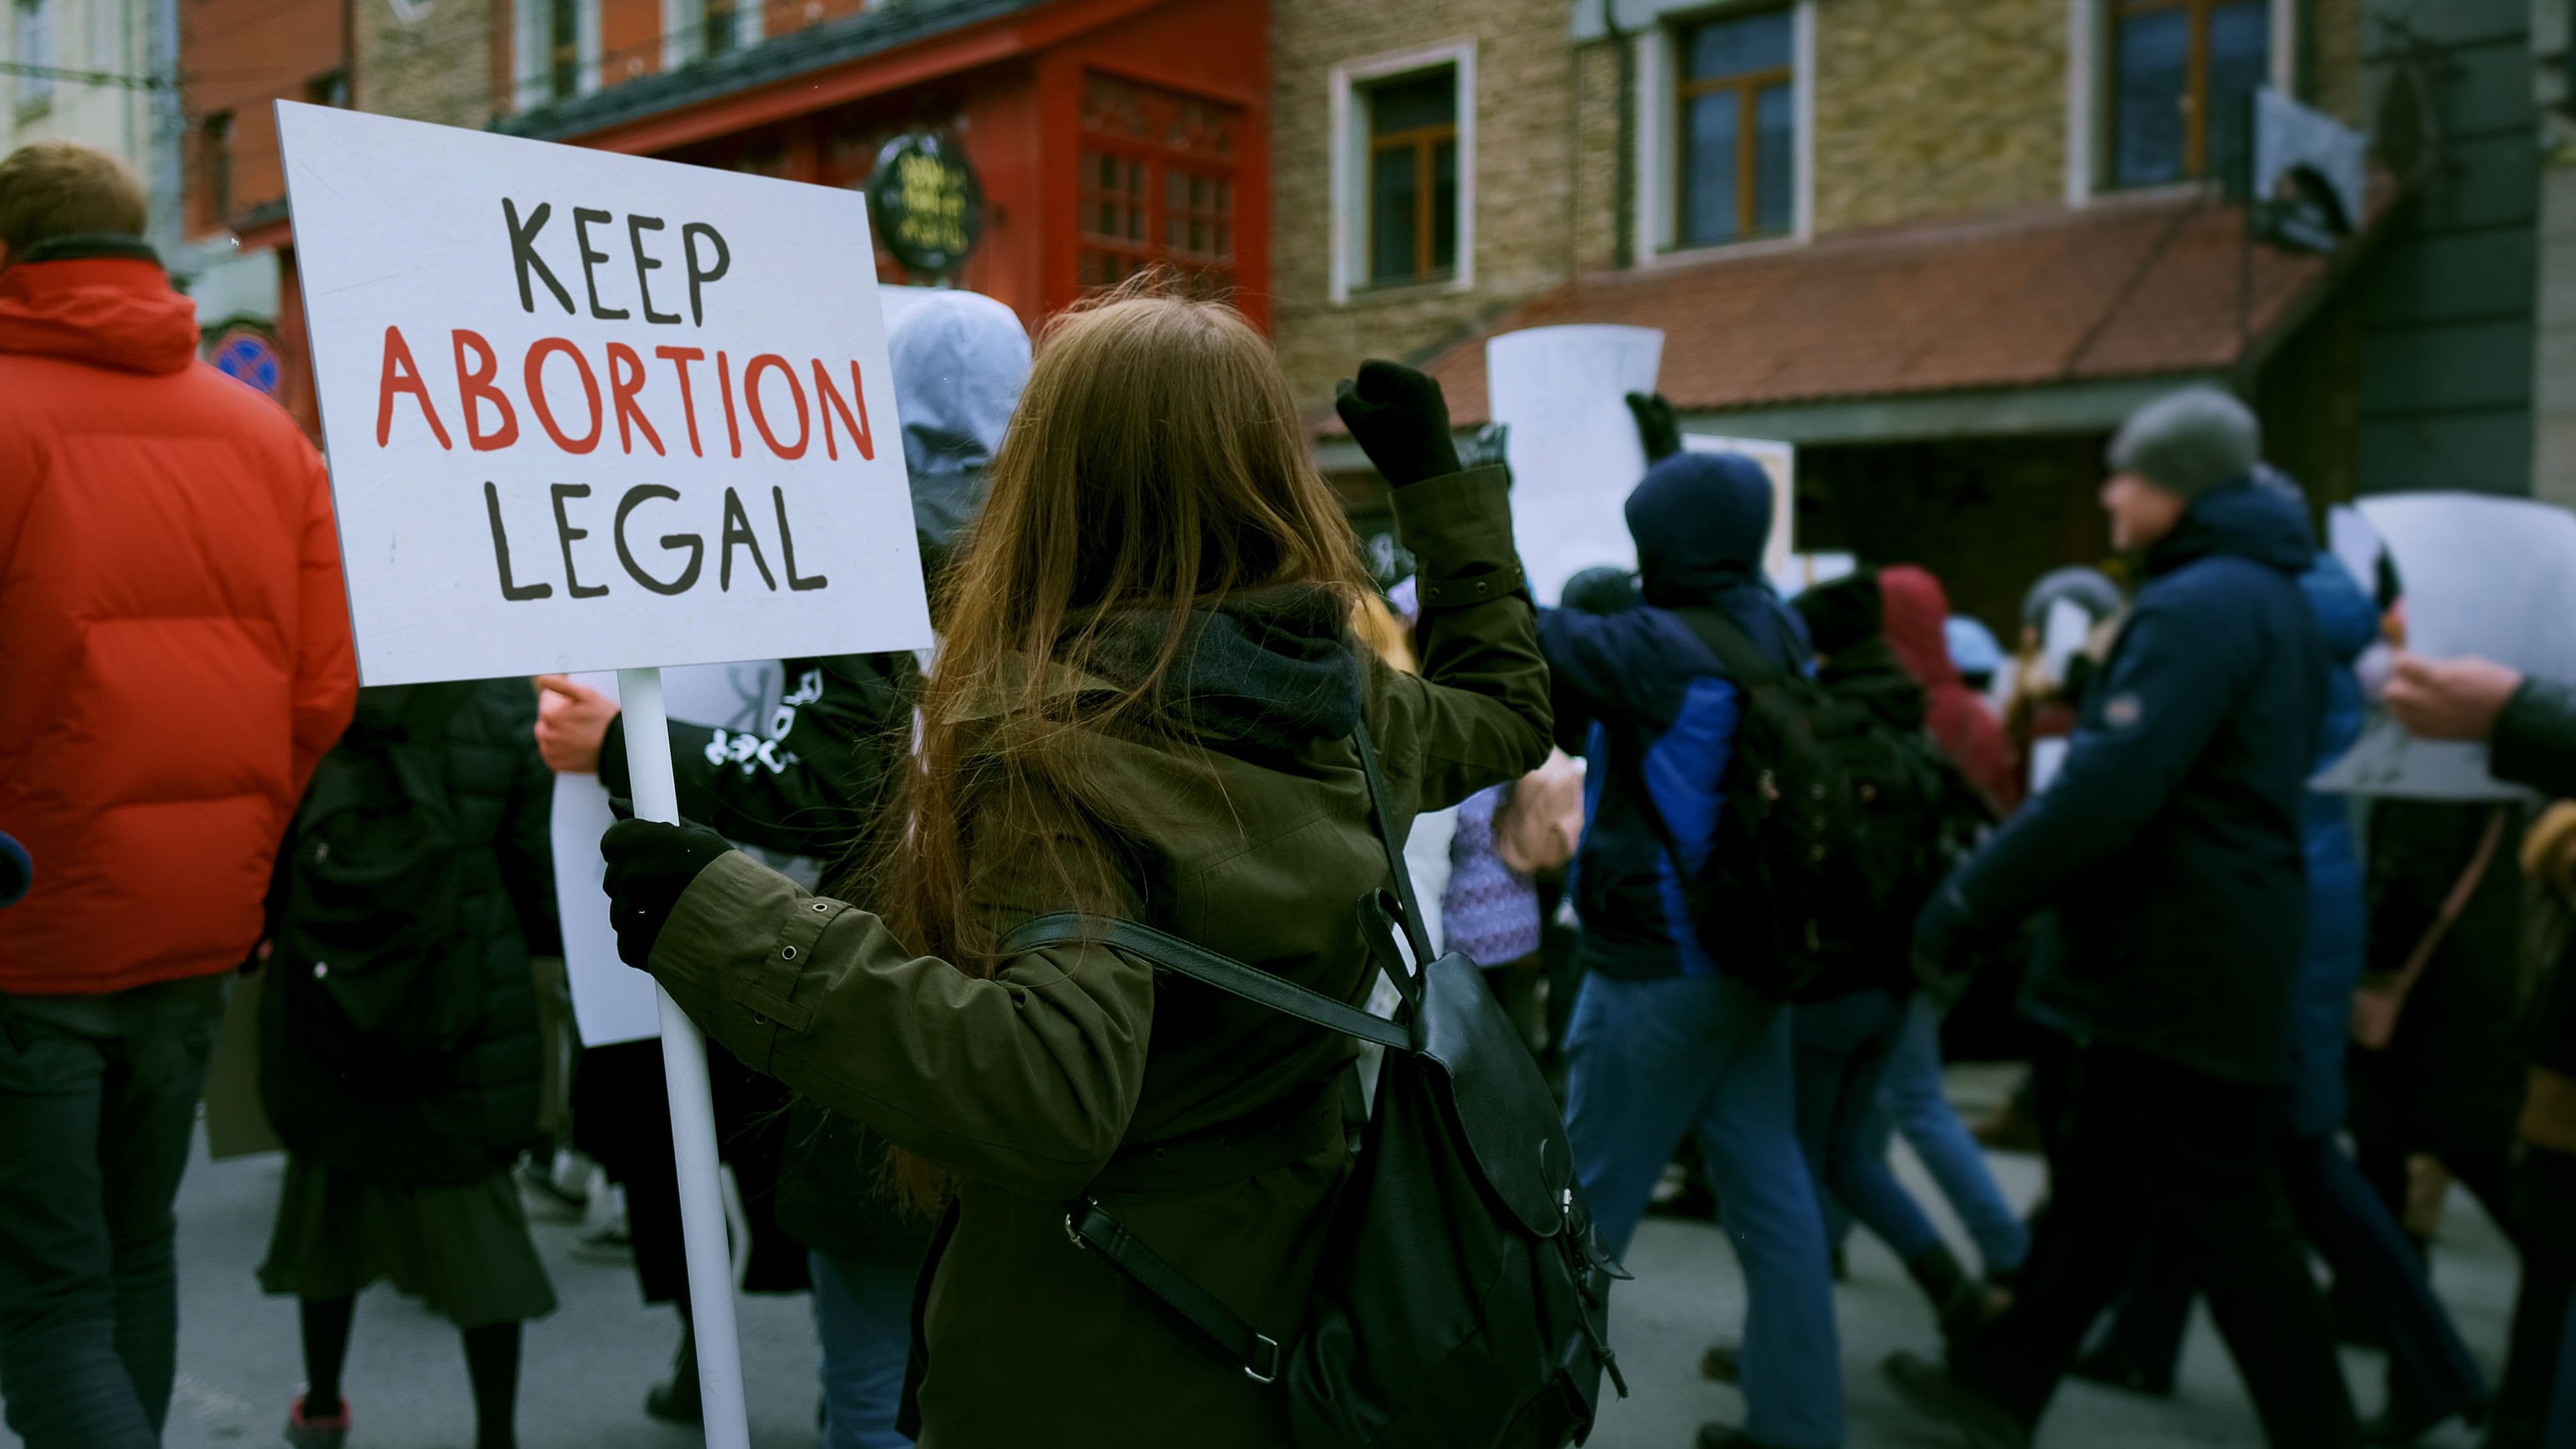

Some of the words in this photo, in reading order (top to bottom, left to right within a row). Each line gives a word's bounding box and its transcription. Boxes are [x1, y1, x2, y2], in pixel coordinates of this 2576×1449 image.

[501, 197, 731, 328] KEEP
[376, 325, 875, 461] ABORTION
[484, 481, 828, 602] LEGAL
